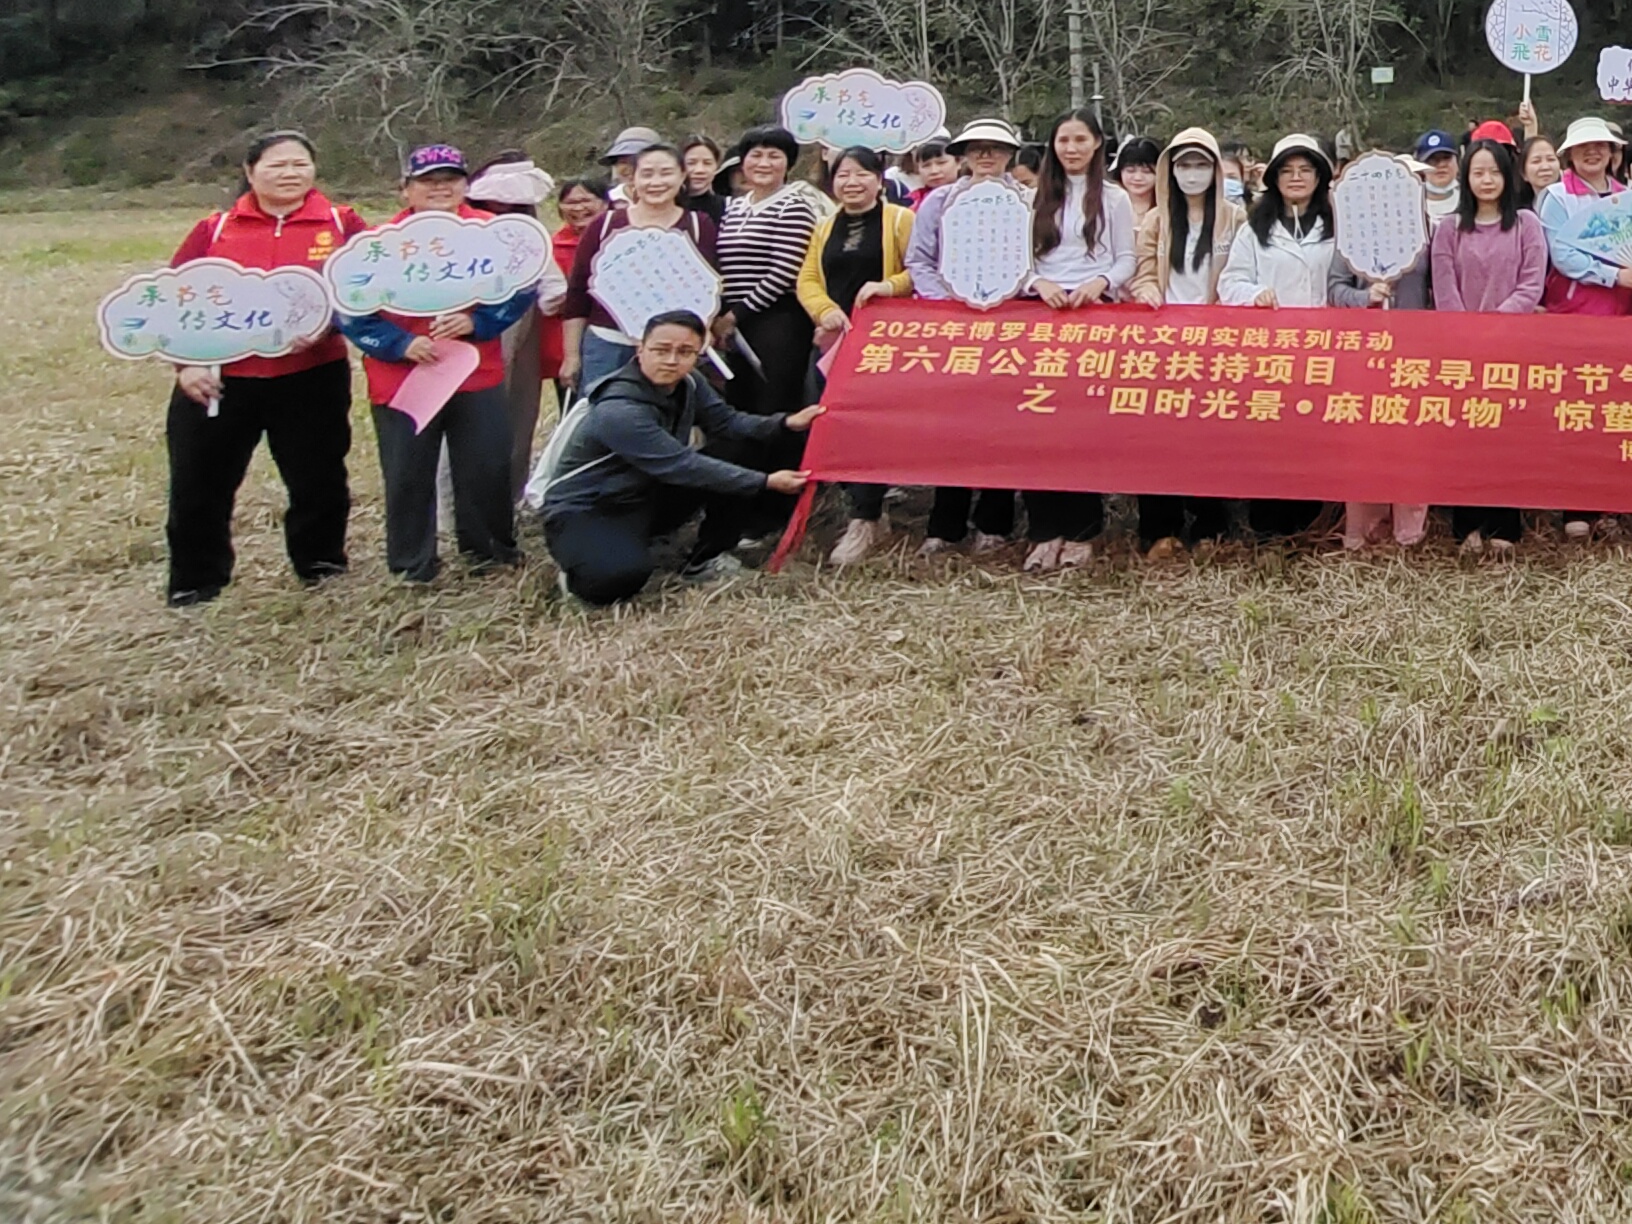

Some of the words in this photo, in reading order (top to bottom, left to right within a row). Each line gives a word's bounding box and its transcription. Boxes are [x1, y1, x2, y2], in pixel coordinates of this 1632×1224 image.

[837, 108, 901, 129] 传文化
[403, 258, 495, 283] 传文化
[179, 310, 274, 331] 传文化
[869, 321, 1394, 352] 2025年博罗县新时代文明实践系列活动
